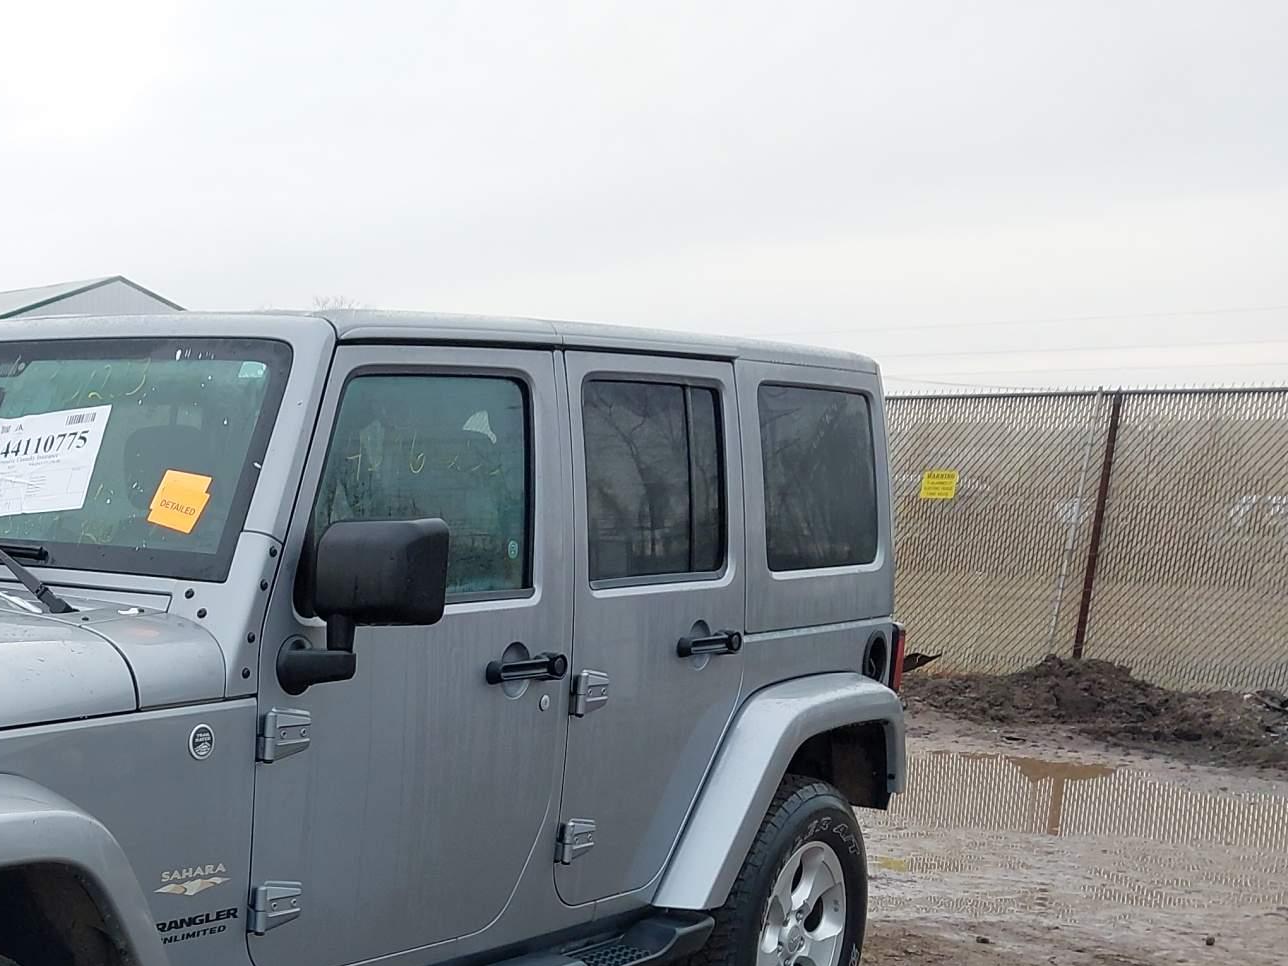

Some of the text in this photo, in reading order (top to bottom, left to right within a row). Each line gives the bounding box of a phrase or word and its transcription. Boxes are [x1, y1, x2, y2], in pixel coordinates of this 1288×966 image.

[0, 430, 90, 458] 44110775
[159, 499, 196, 516] DETAILED
[161, 863, 226, 882] SAHARA
[155, 907, 239, 932] RANGLER
[160, 925, 226, 944] NLIMITED
